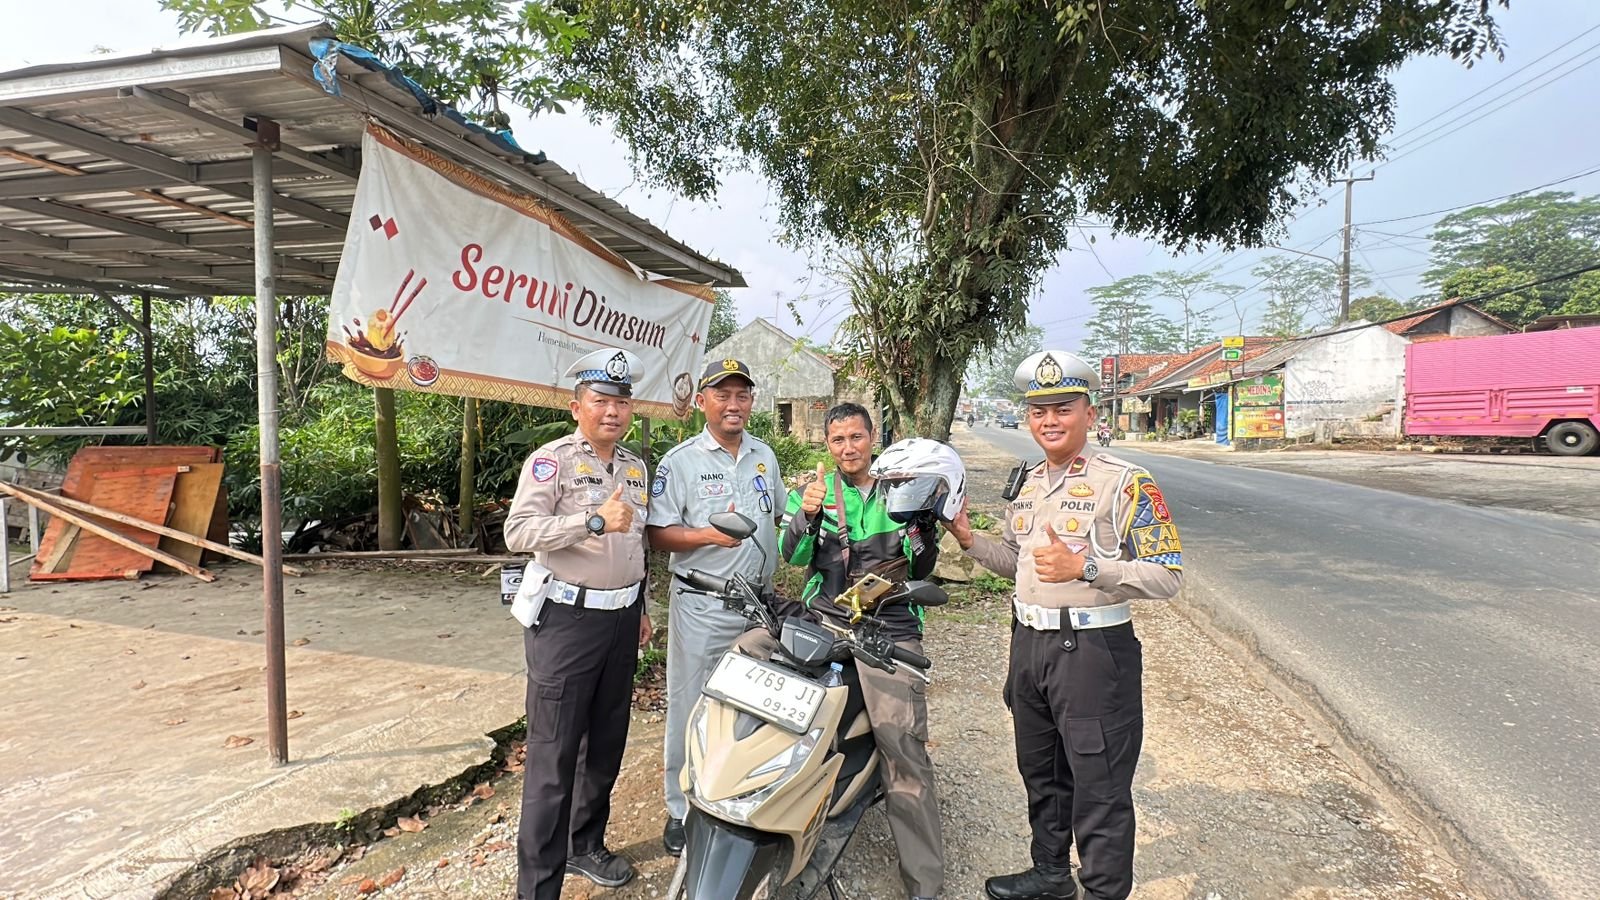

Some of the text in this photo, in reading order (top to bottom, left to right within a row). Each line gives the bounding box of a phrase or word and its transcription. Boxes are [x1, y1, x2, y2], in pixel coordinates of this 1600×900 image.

[452, 243, 666, 349] Seruni Dimsum
[700, 473, 724, 481] NANO
[1060, 500, 1096, 512] POLRI
[795, 631, 818, 644] HONDA
[725, 657, 736, 670] T
[745, 666, 785, 691] 4769
